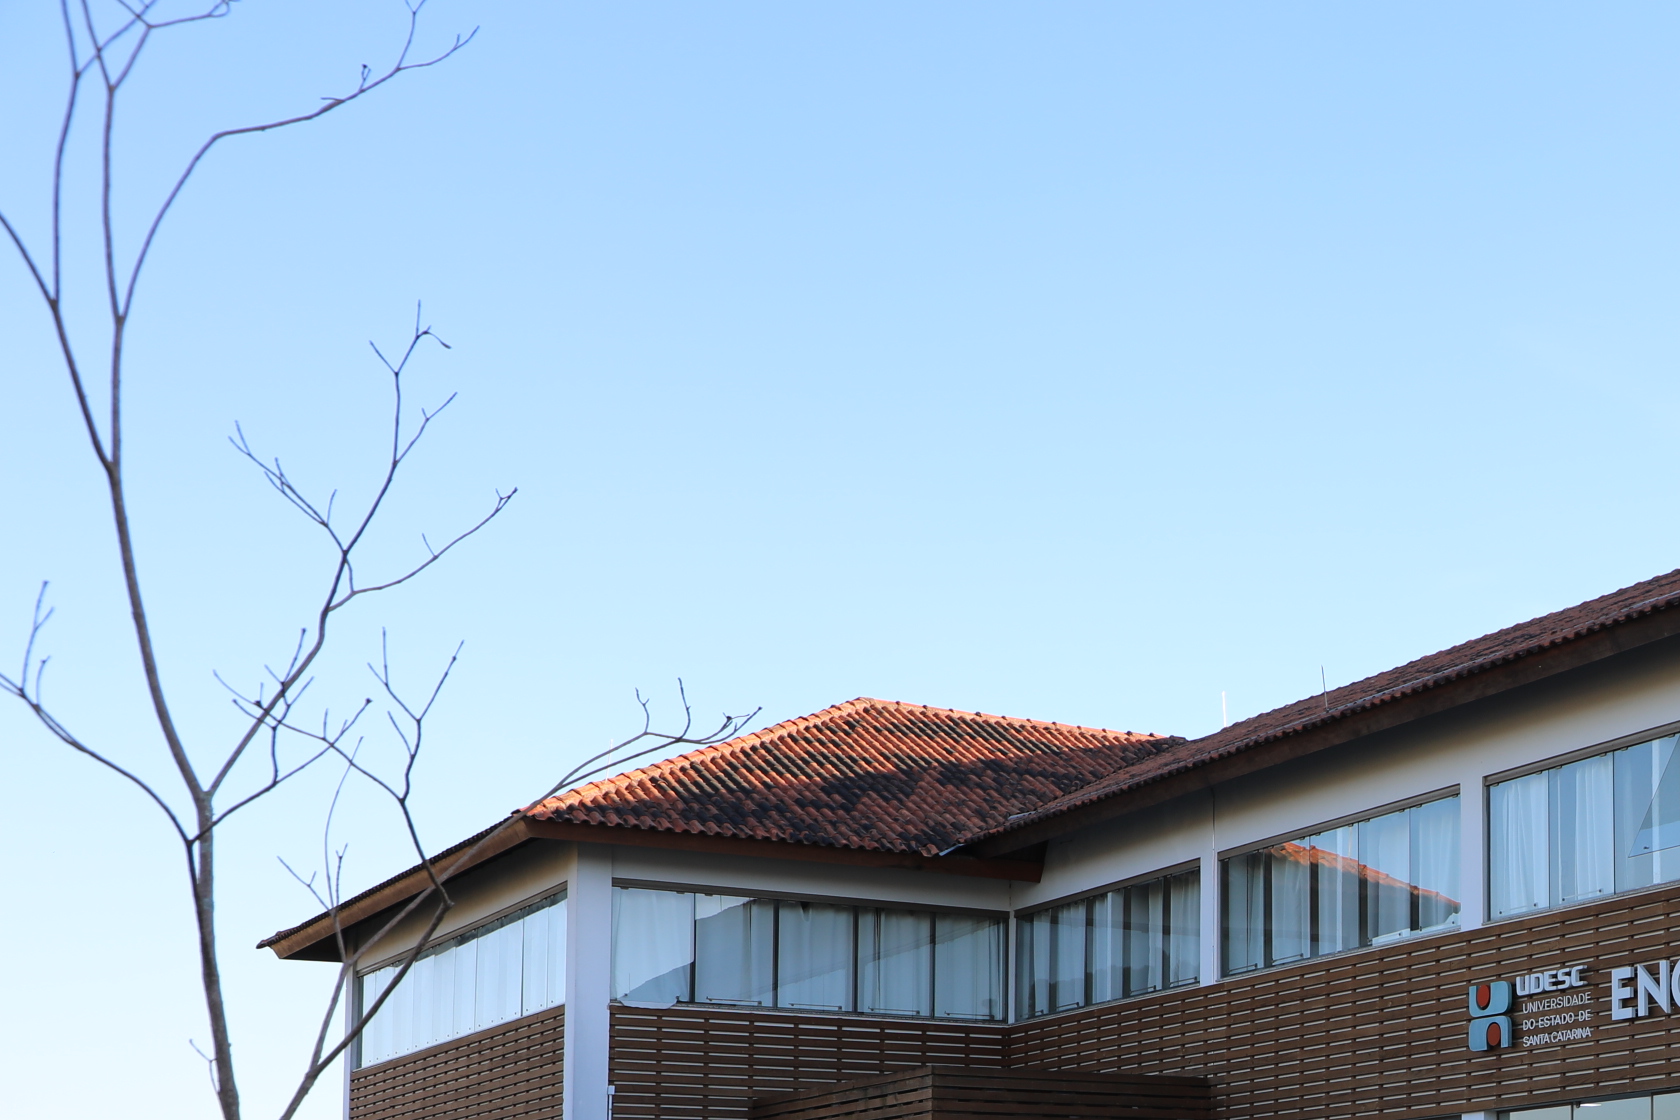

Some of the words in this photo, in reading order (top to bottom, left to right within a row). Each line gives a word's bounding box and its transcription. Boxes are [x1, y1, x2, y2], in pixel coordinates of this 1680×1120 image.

[1516, 965, 1588, 996] UDESC
[1523, 992, 1591, 1014] UNIVERSIDADE
[1523, 1018, 1535, 1031] DO
[1538, 1012, 1575, 1029] ESTADO
[1579, 1009, 1591, 1022] DE
[1523, 1033, 1550, 1047] SANTA
[1551, 1027, 1591, 1043] CATARINA
